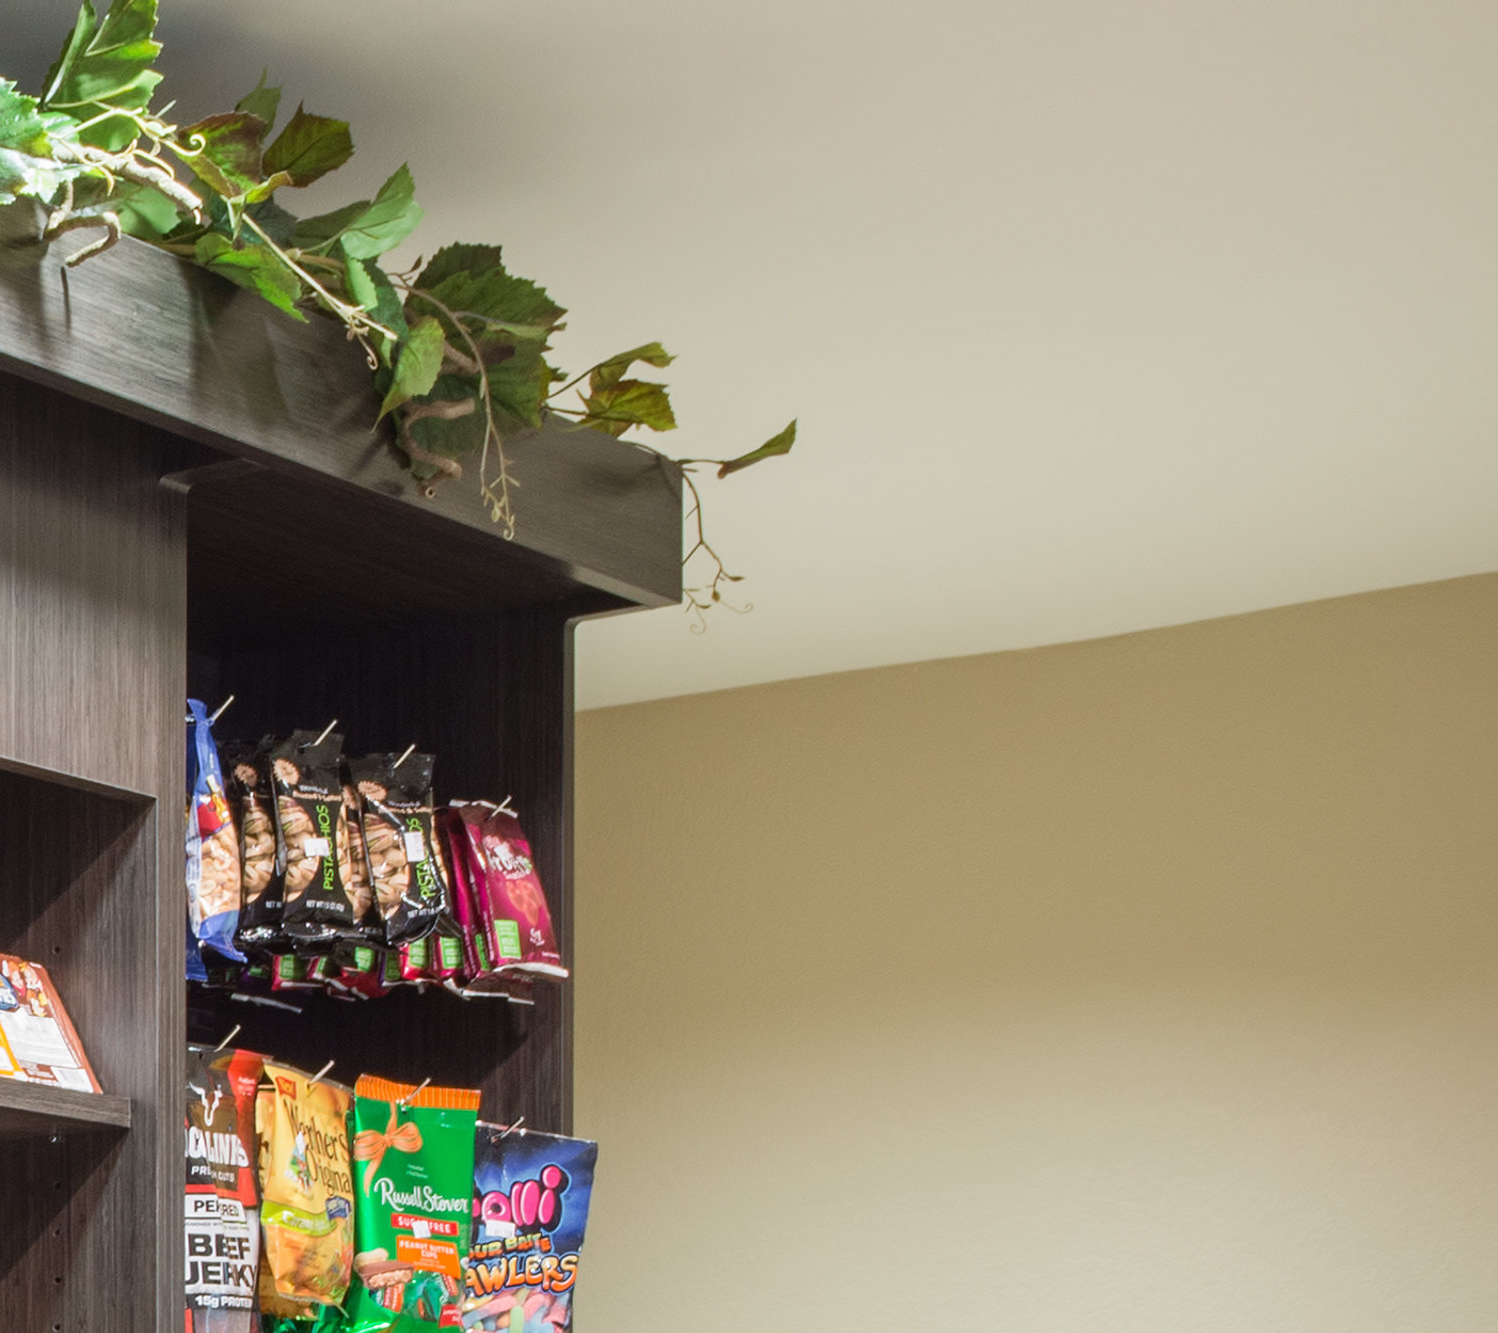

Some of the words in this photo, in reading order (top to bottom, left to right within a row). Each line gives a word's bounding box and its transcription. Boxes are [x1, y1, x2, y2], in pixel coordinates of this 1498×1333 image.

[283, 1098, 350, 1163] Werther's
[374, 1177, 422, 1210] Russell
[422, 1186, 469, 1213] Stover
[429, 1221, 451, 1234] FREE
[420, 1250, 438, 1260] CUPS
[428, 1244, 455, 1255] BUTTER
